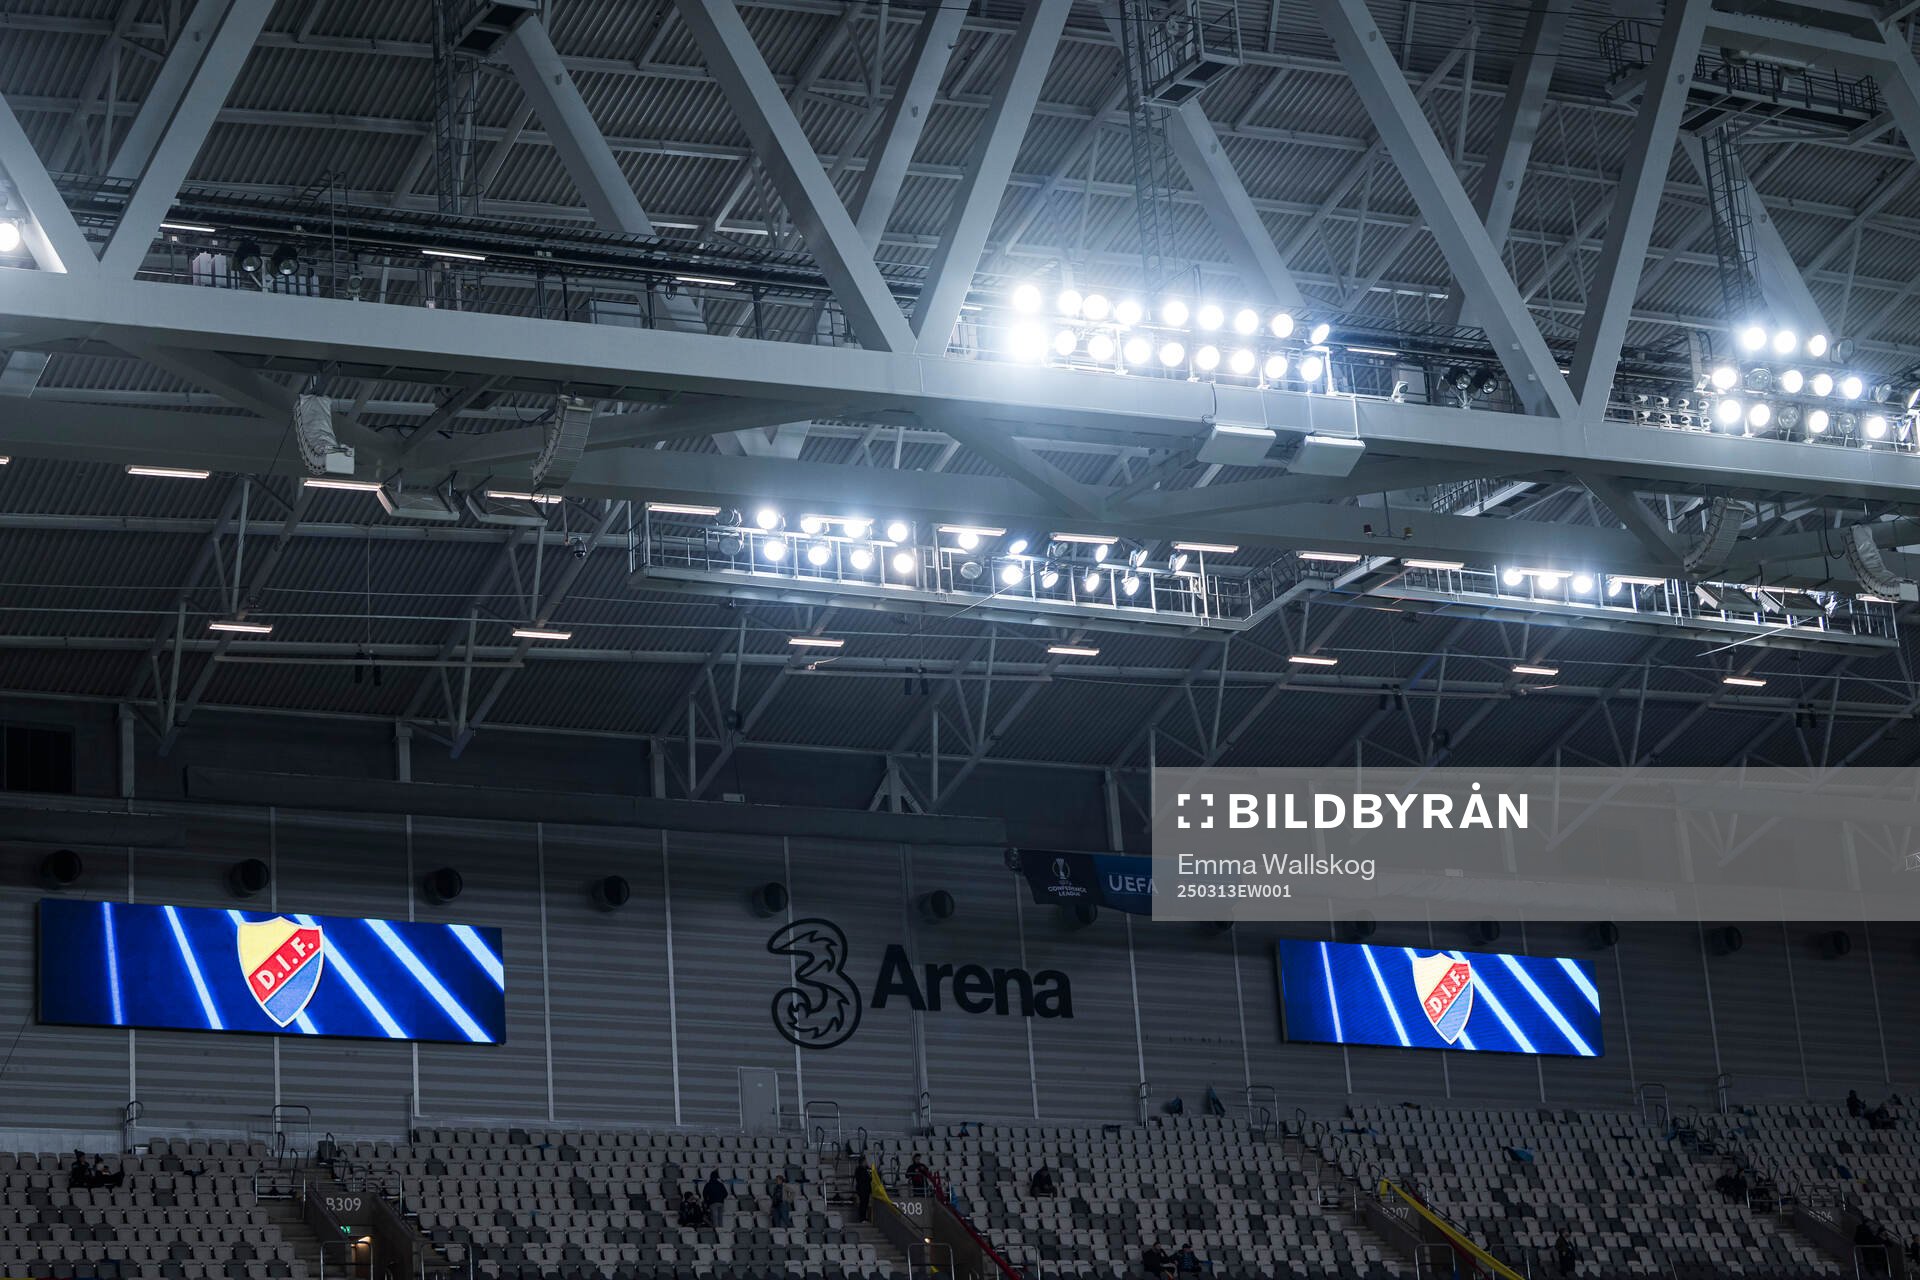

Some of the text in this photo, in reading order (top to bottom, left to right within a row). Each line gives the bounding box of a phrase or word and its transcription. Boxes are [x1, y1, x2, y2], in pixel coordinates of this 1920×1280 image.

[1109, 874, 1159, 895] UEFA
[256, 936, 314, 990] D.I.F.
[870, 944, 1074, 1018] Arena
[1429, 970, 1466, 1014] D.I.F.
[326, 1197, 362, 1211] B309
